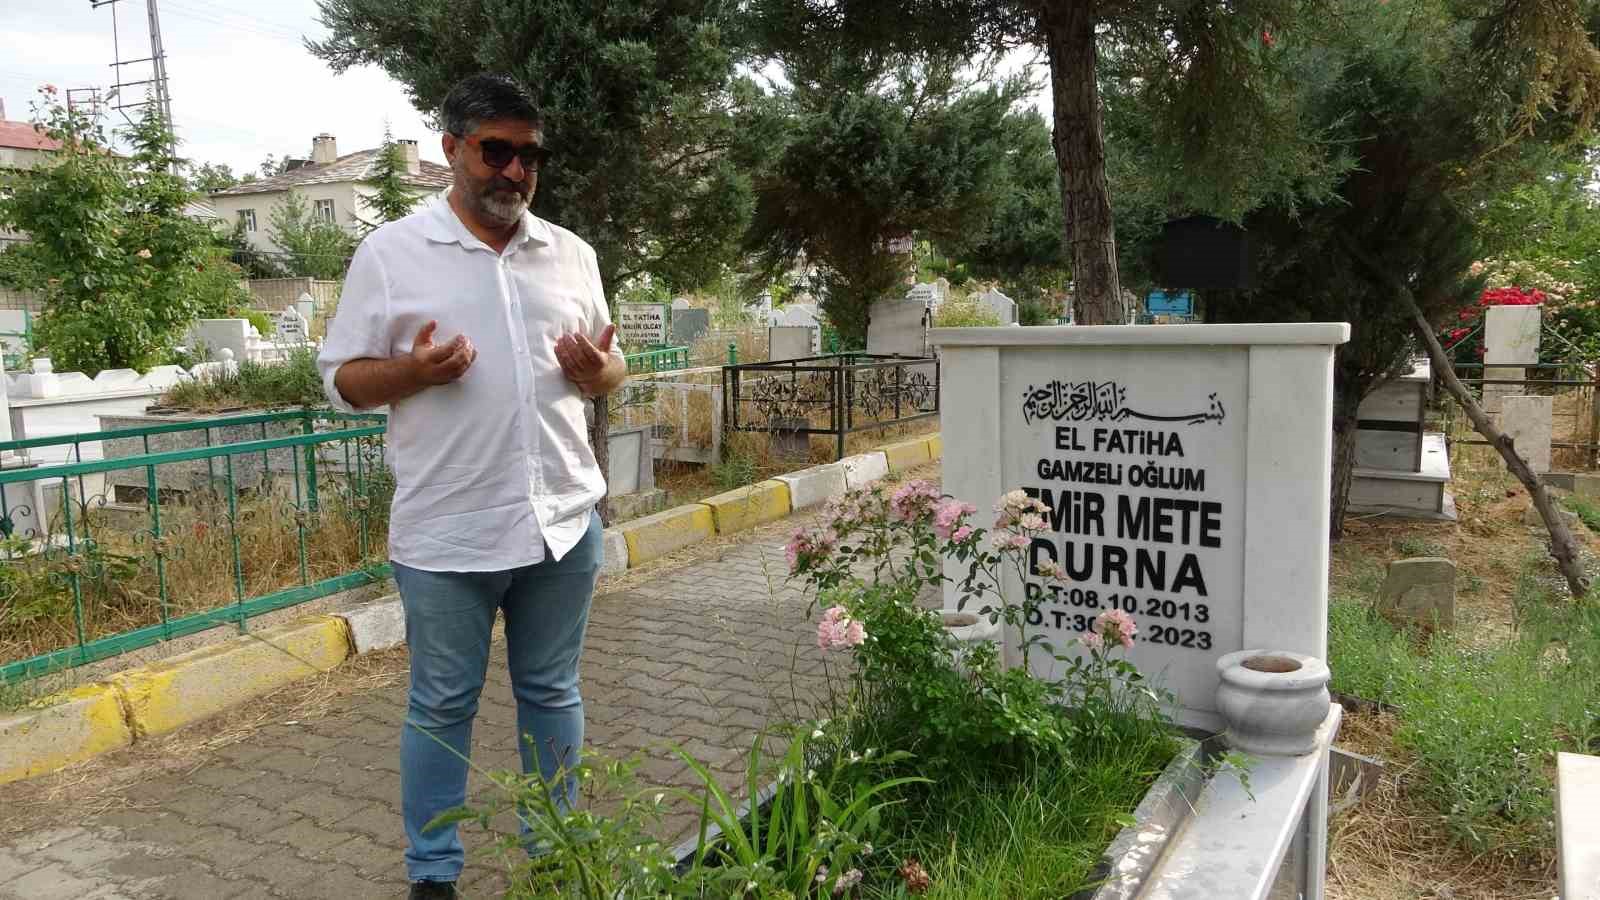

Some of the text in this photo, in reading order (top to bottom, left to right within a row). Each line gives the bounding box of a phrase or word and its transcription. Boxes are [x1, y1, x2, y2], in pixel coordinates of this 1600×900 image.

[1055, 426, 1086, 452] EL
[1128, 461, 1206, 492] OĞLUM
[1117, 494, 1223, 549] METE
[1029, 537, 1209, 597] DURNA
